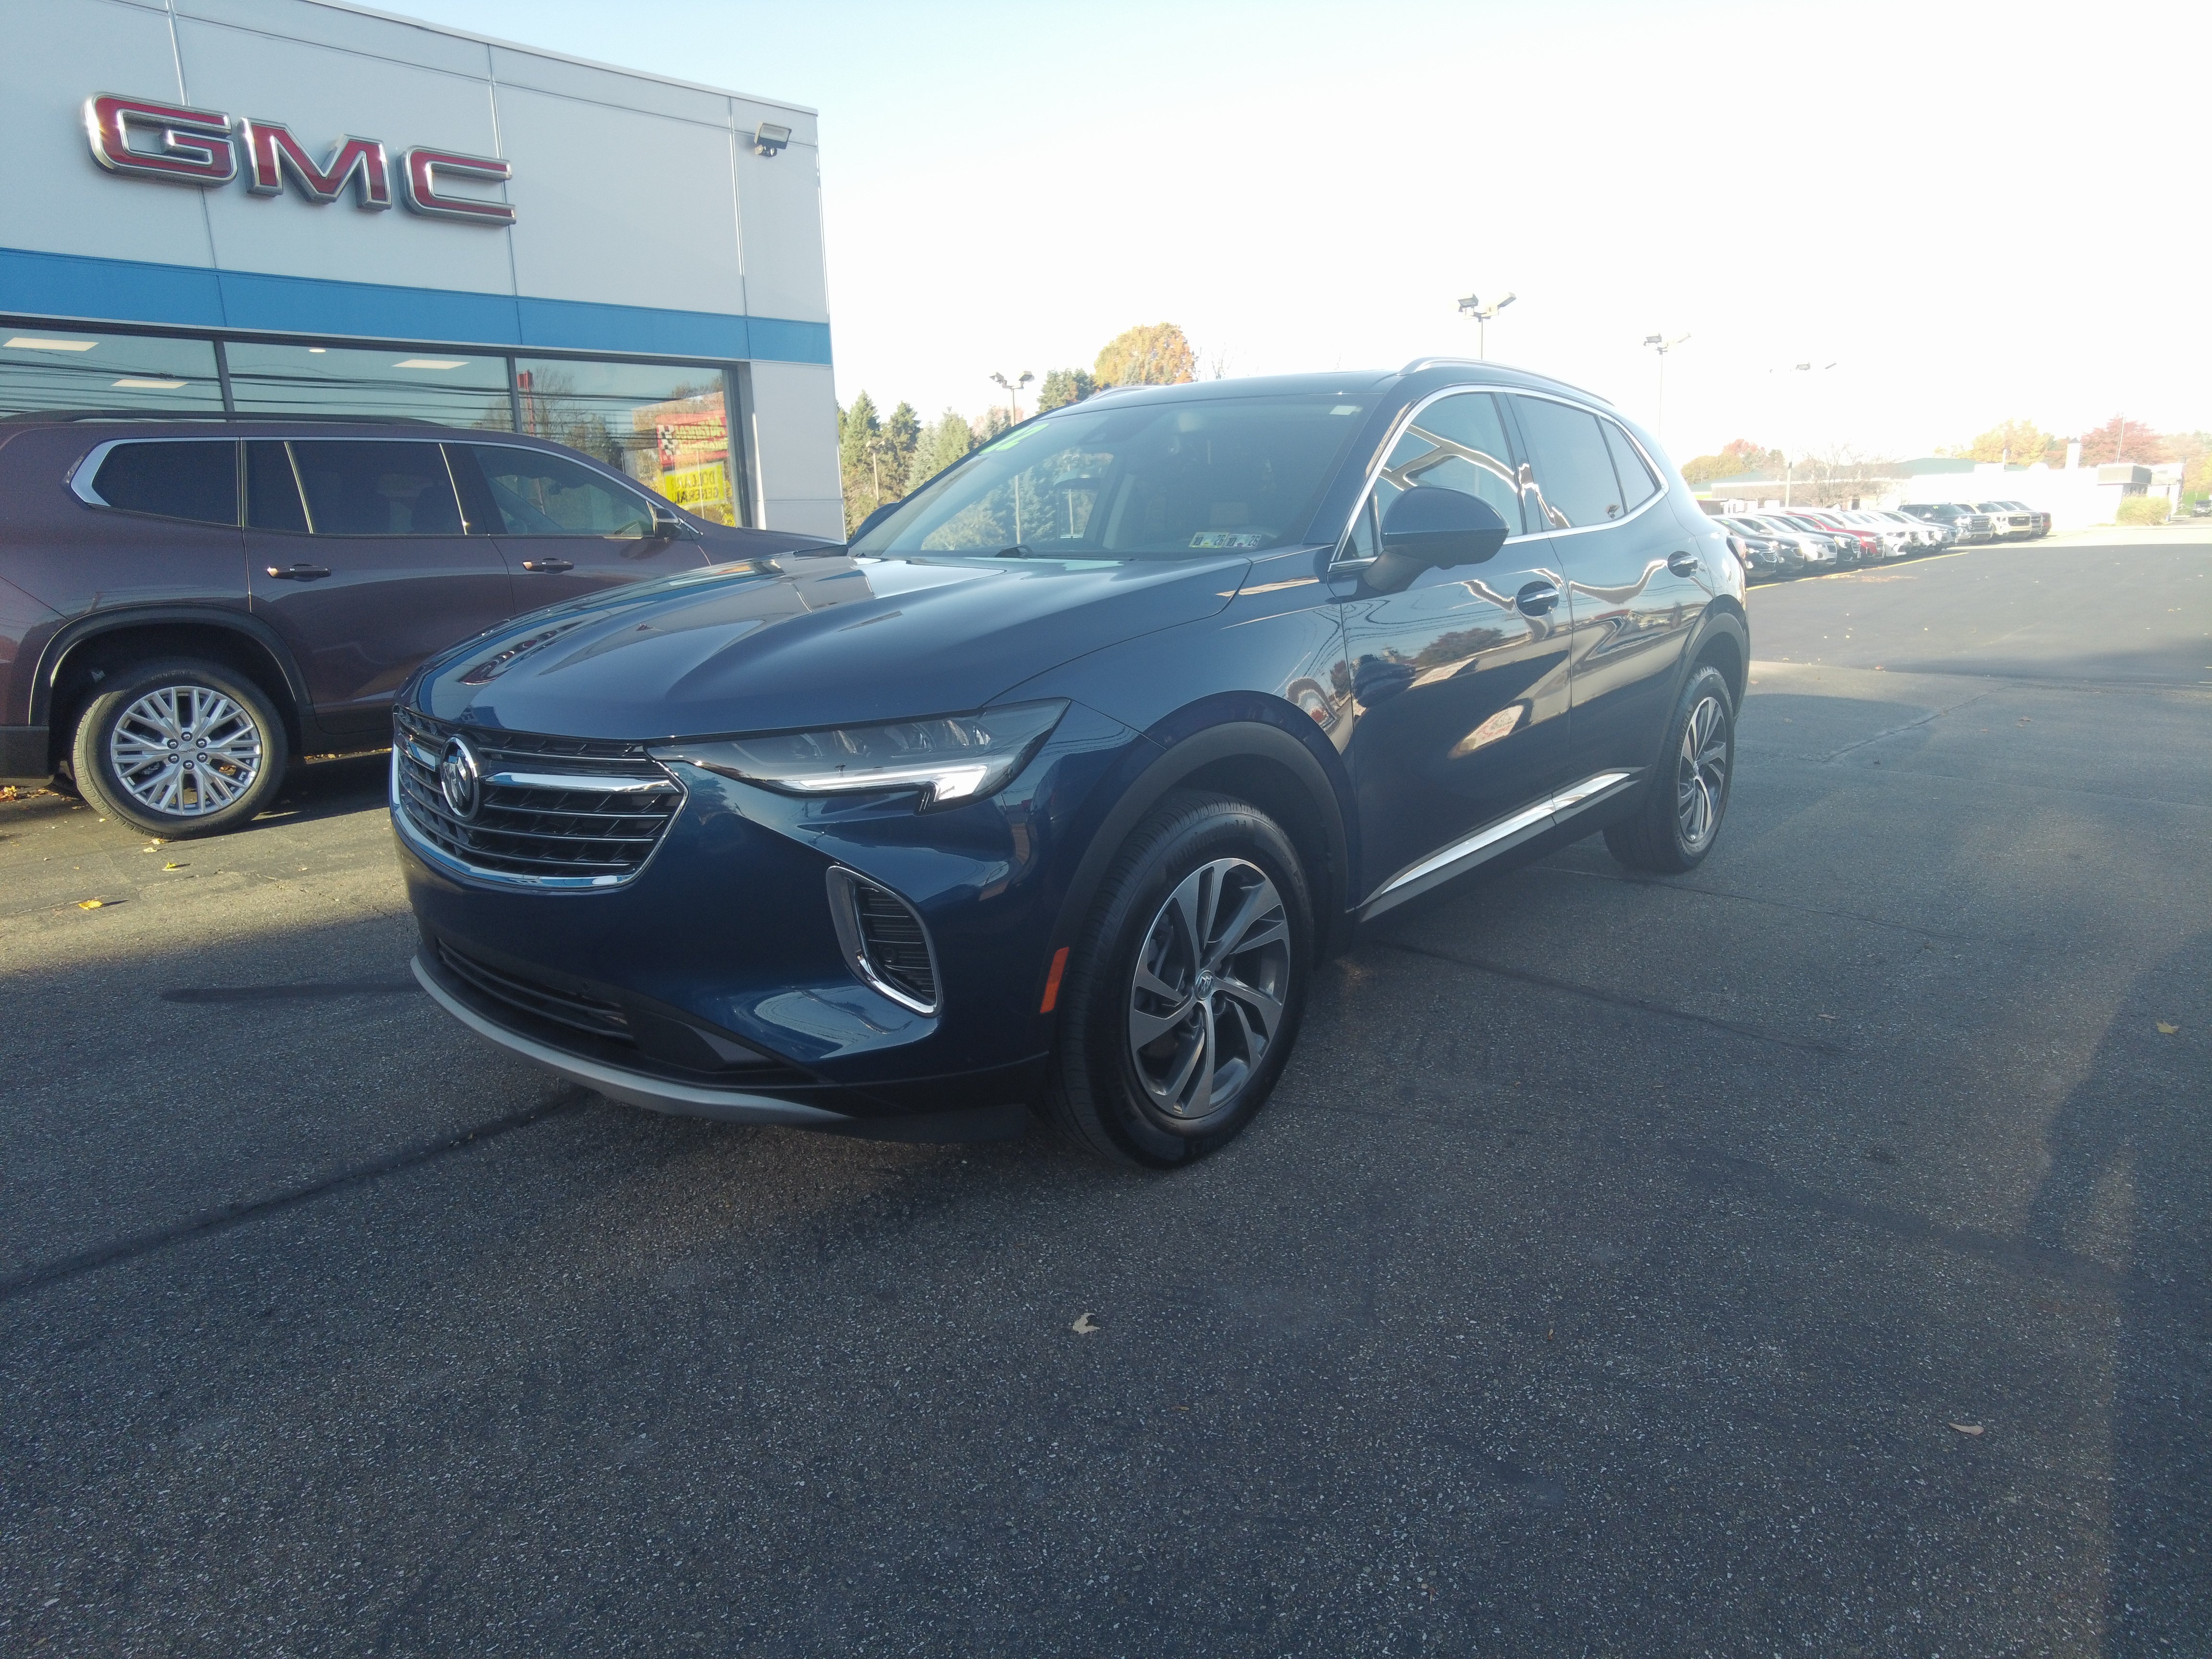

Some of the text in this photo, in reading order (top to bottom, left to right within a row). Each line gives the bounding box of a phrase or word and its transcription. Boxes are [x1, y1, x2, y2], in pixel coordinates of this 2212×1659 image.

[83, 92, 517, 227] GMC
[1193, 534, 1226, 545] 10 26
[1226, 535, 1260, 546] 10 26
